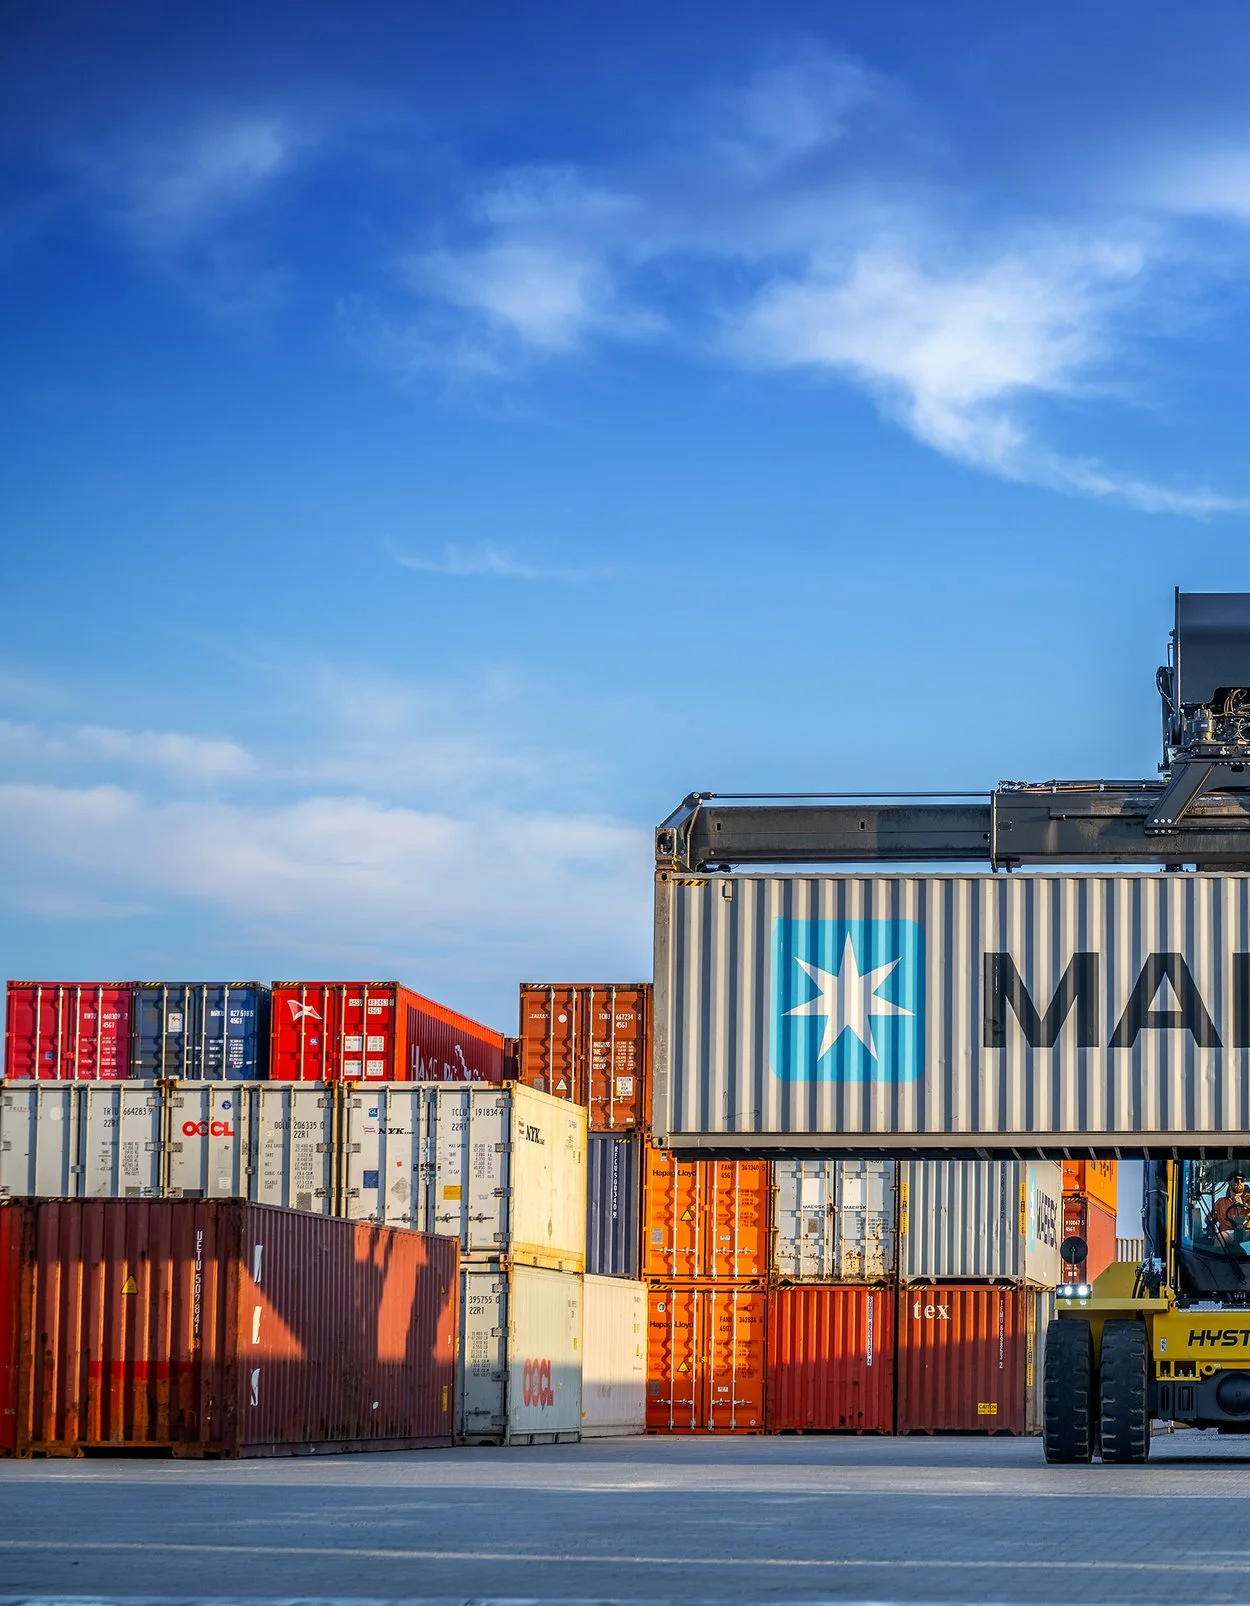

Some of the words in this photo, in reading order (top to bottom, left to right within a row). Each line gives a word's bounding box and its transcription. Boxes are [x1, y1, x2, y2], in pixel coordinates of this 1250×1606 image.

[182, 1121, 235, 1136] OOCL
[452, 1123, 467, 1131] 22R1
[526, 1125, 540, 1144] NYK
[912, 1300, 951, 1320] tex
